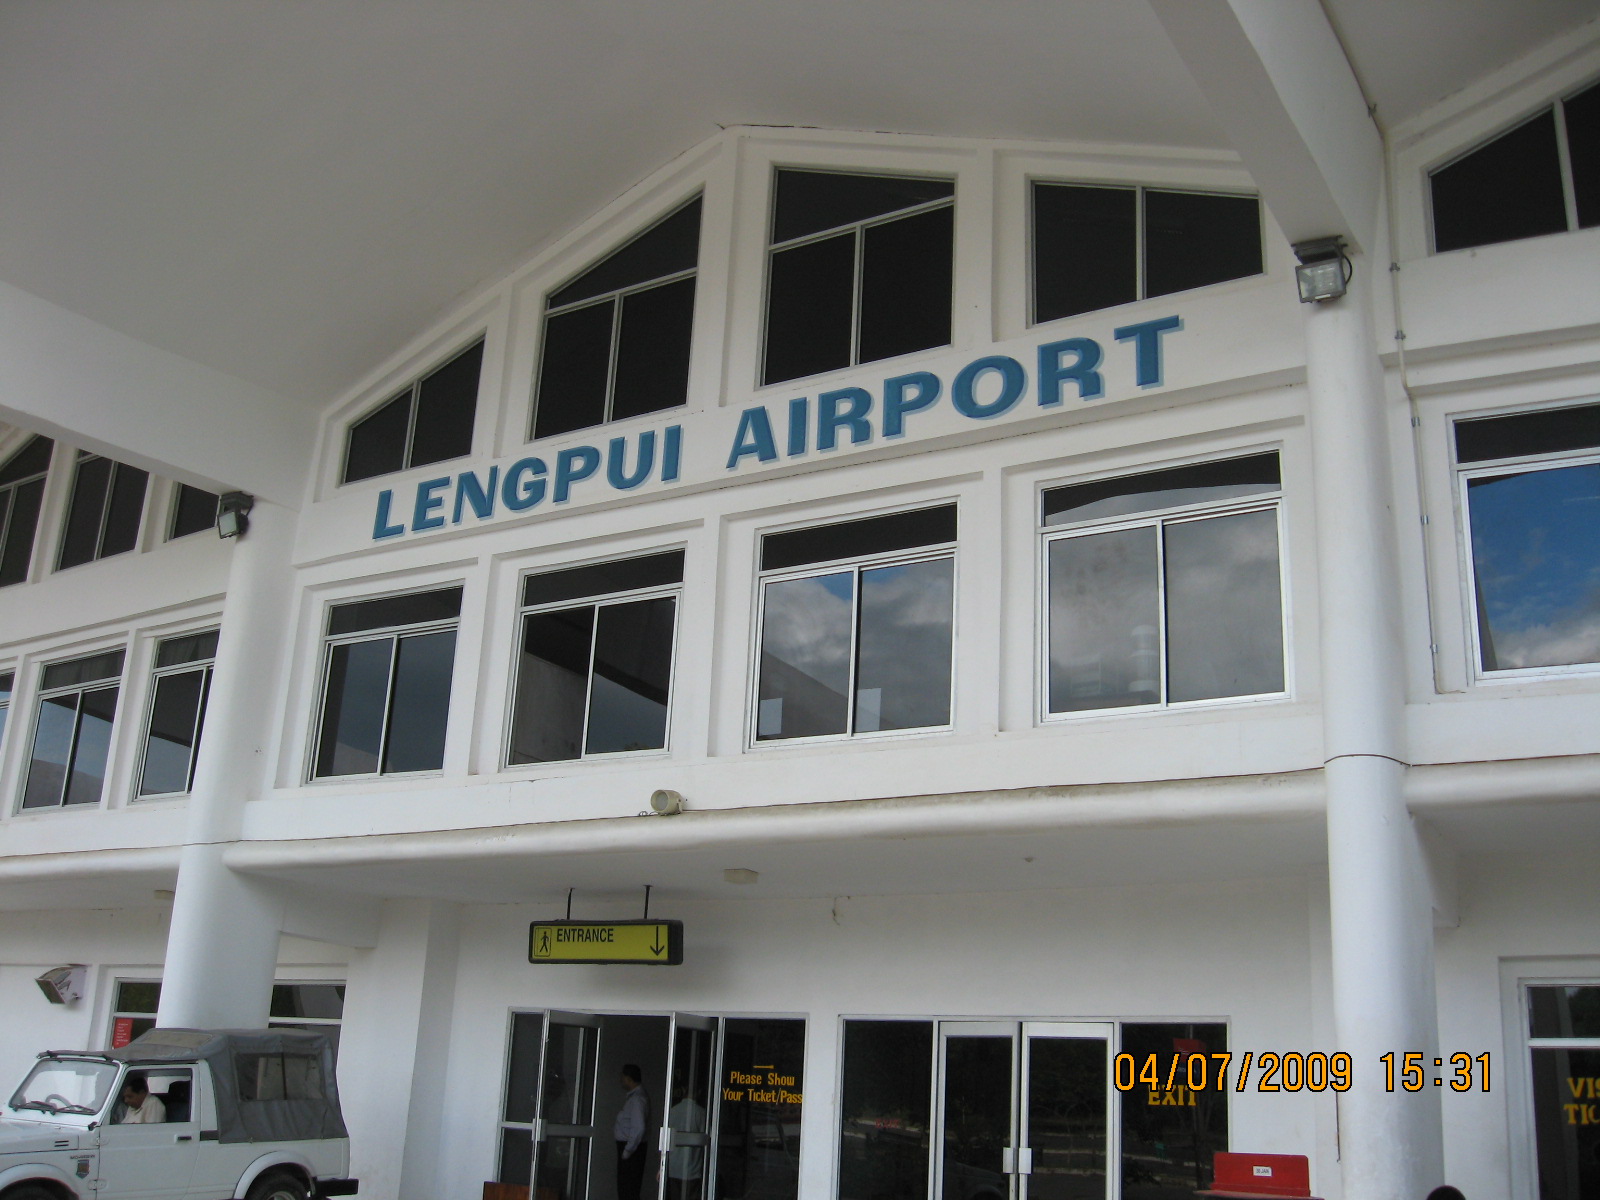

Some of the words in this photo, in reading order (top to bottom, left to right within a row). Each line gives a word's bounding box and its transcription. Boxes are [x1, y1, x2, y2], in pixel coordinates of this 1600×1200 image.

[372, 424, 684, 540] LENGPUI
[725, 315, 1183, 470] AIRPORT
[556, 928, 614, 943] ENTRANCE
[730, 1071, 762, 1085] Please
[767, 1073, 795, 1086] Show
[722, 1087, 744, 1101] Your
[747, 1087, 803, 1106] Ticket/Pass
[1147, 1084, 1197, 1106] EXIT
